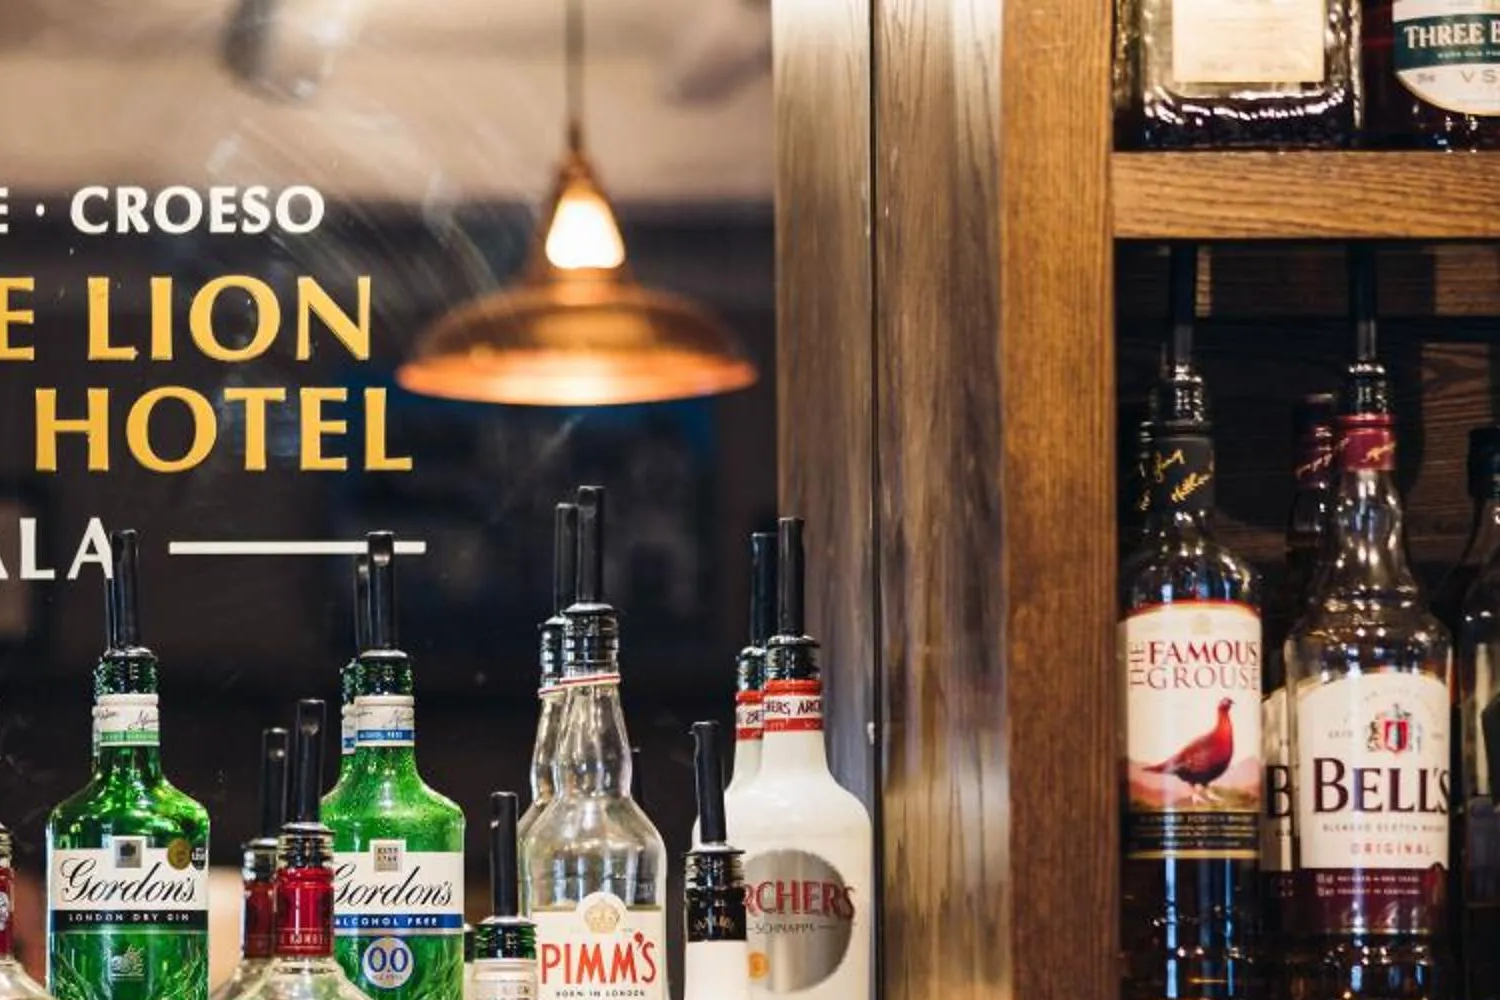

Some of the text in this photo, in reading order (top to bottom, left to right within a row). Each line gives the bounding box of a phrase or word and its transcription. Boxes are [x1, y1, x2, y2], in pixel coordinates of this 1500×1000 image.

[1403, 23, 1485, 49] THREE
[70, 185, 326, 235] CROESO
[87, 274, 372, 362] LION
[33, 386, 414, 473] HOTEL
[1149, 639, 1259, 667] FAMOUS
[1313, 757, 1450, 816] BELL'S
[60, 857, 197, 903] Gordon's
[744, 879, 856, 919] RCHERS
[68, 913, 190, 922] LONDON DRY GIN
[541, 931, 657, 985] PIMM'S
